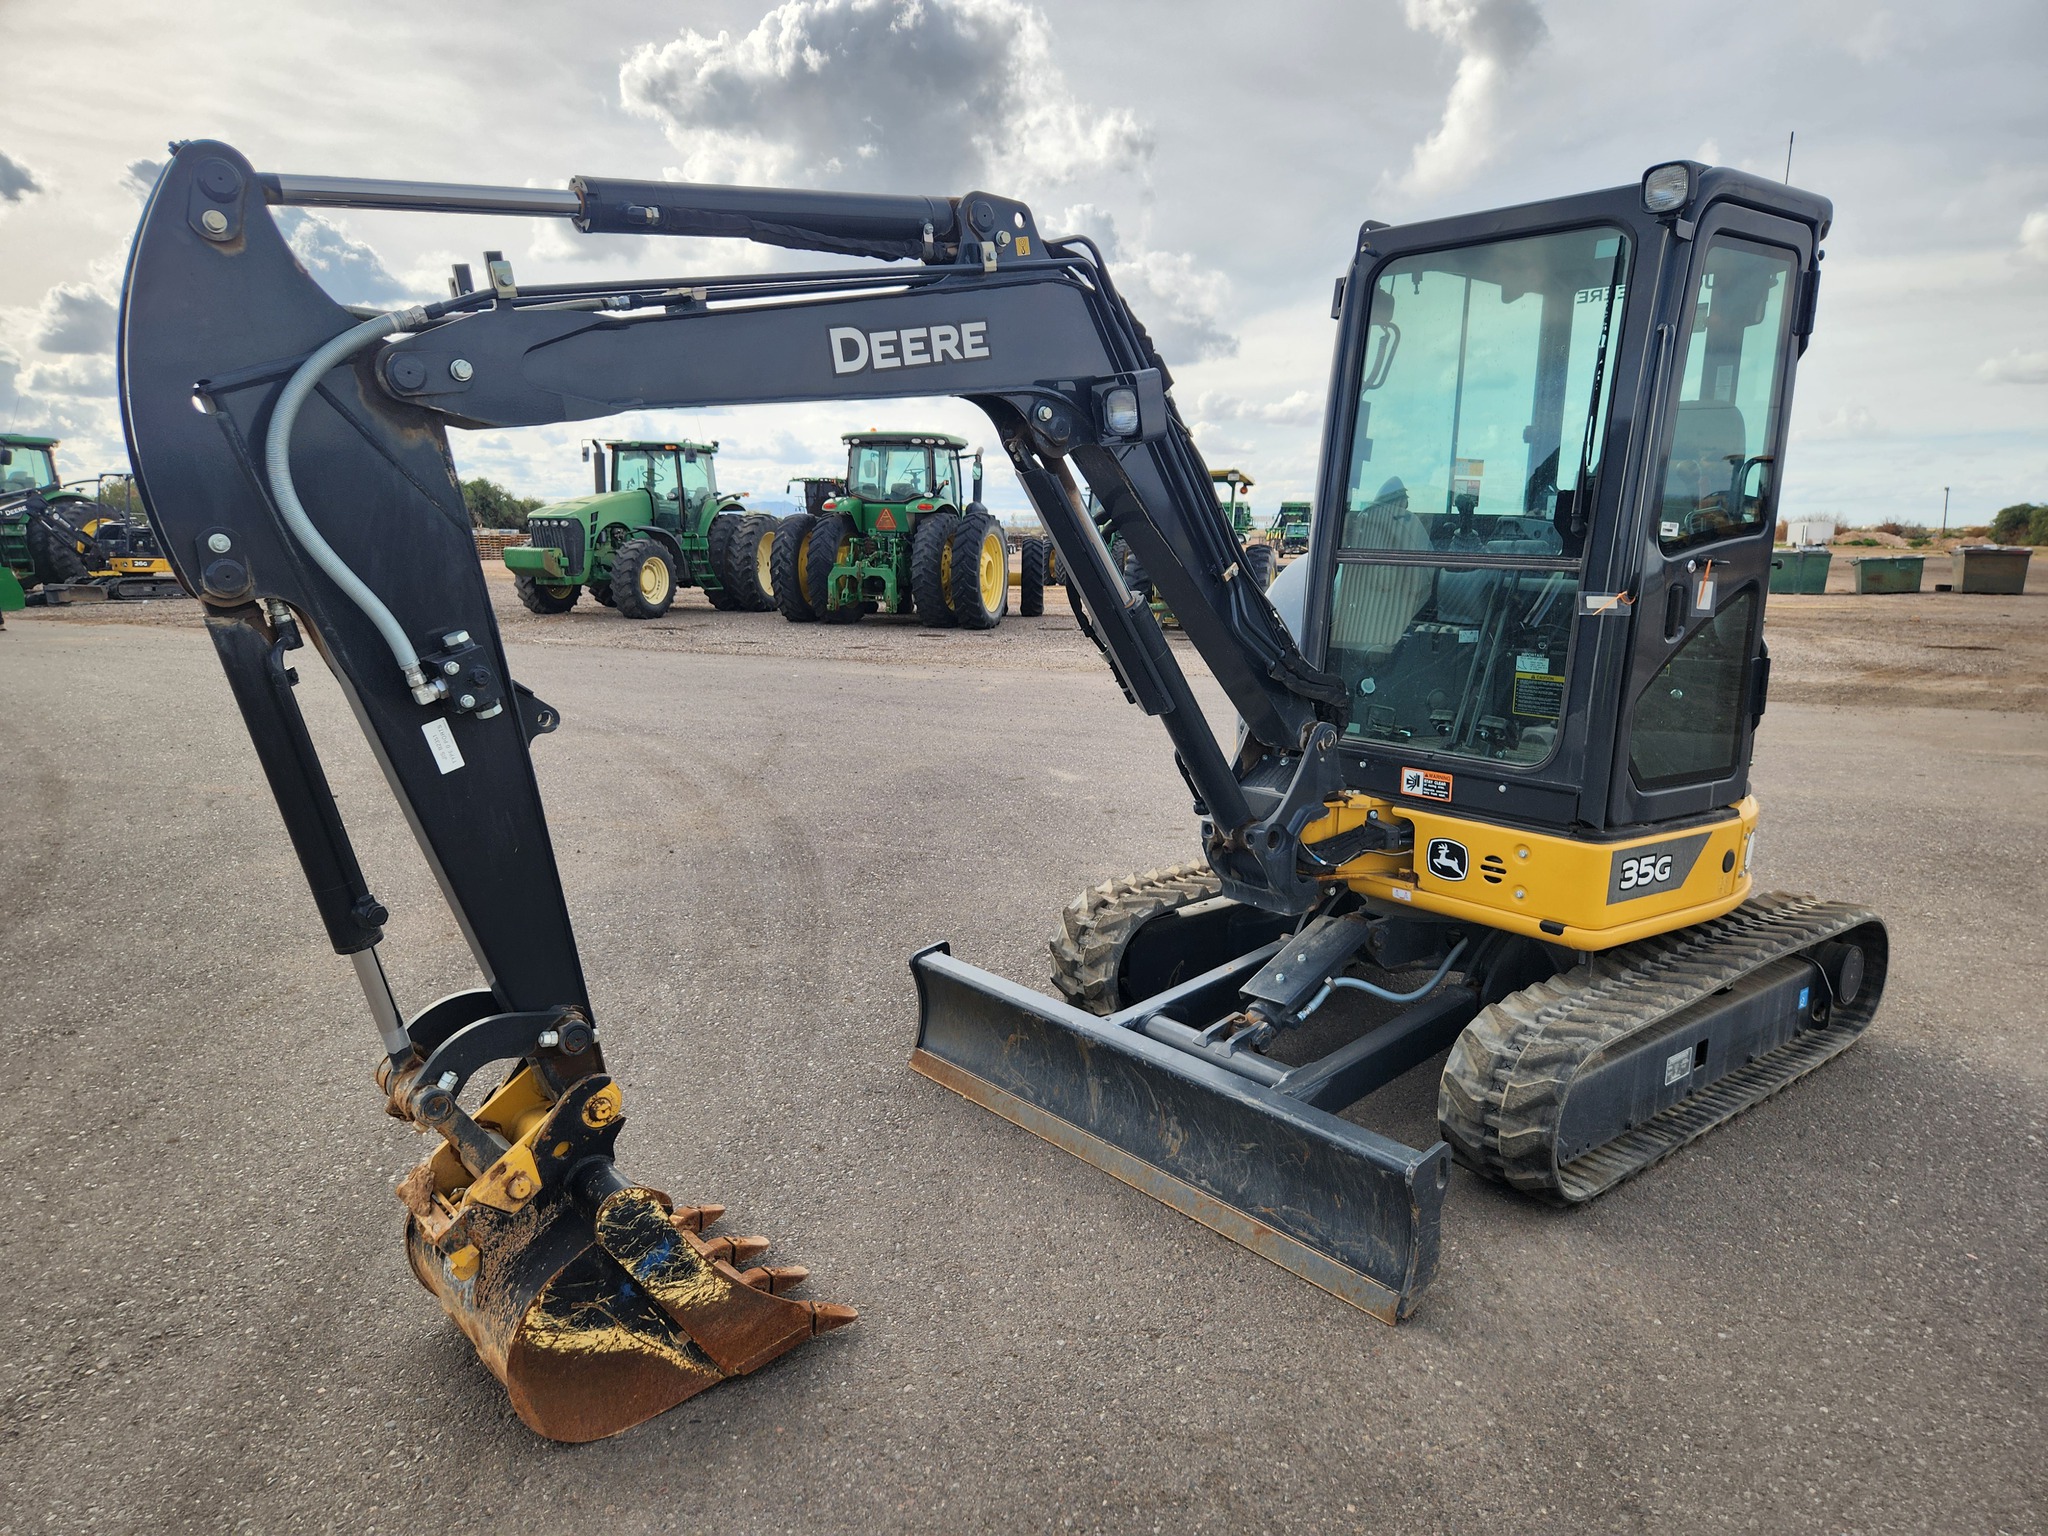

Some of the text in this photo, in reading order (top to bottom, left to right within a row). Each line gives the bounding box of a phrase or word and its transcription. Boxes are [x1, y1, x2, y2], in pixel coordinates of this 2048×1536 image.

[829, 321, 989, 374] DEERE
[5, 505, 28, 516] DEERE
[1427, 773, 1451, 781] WARNING
[1620, 854, 1672, 890] 35G
